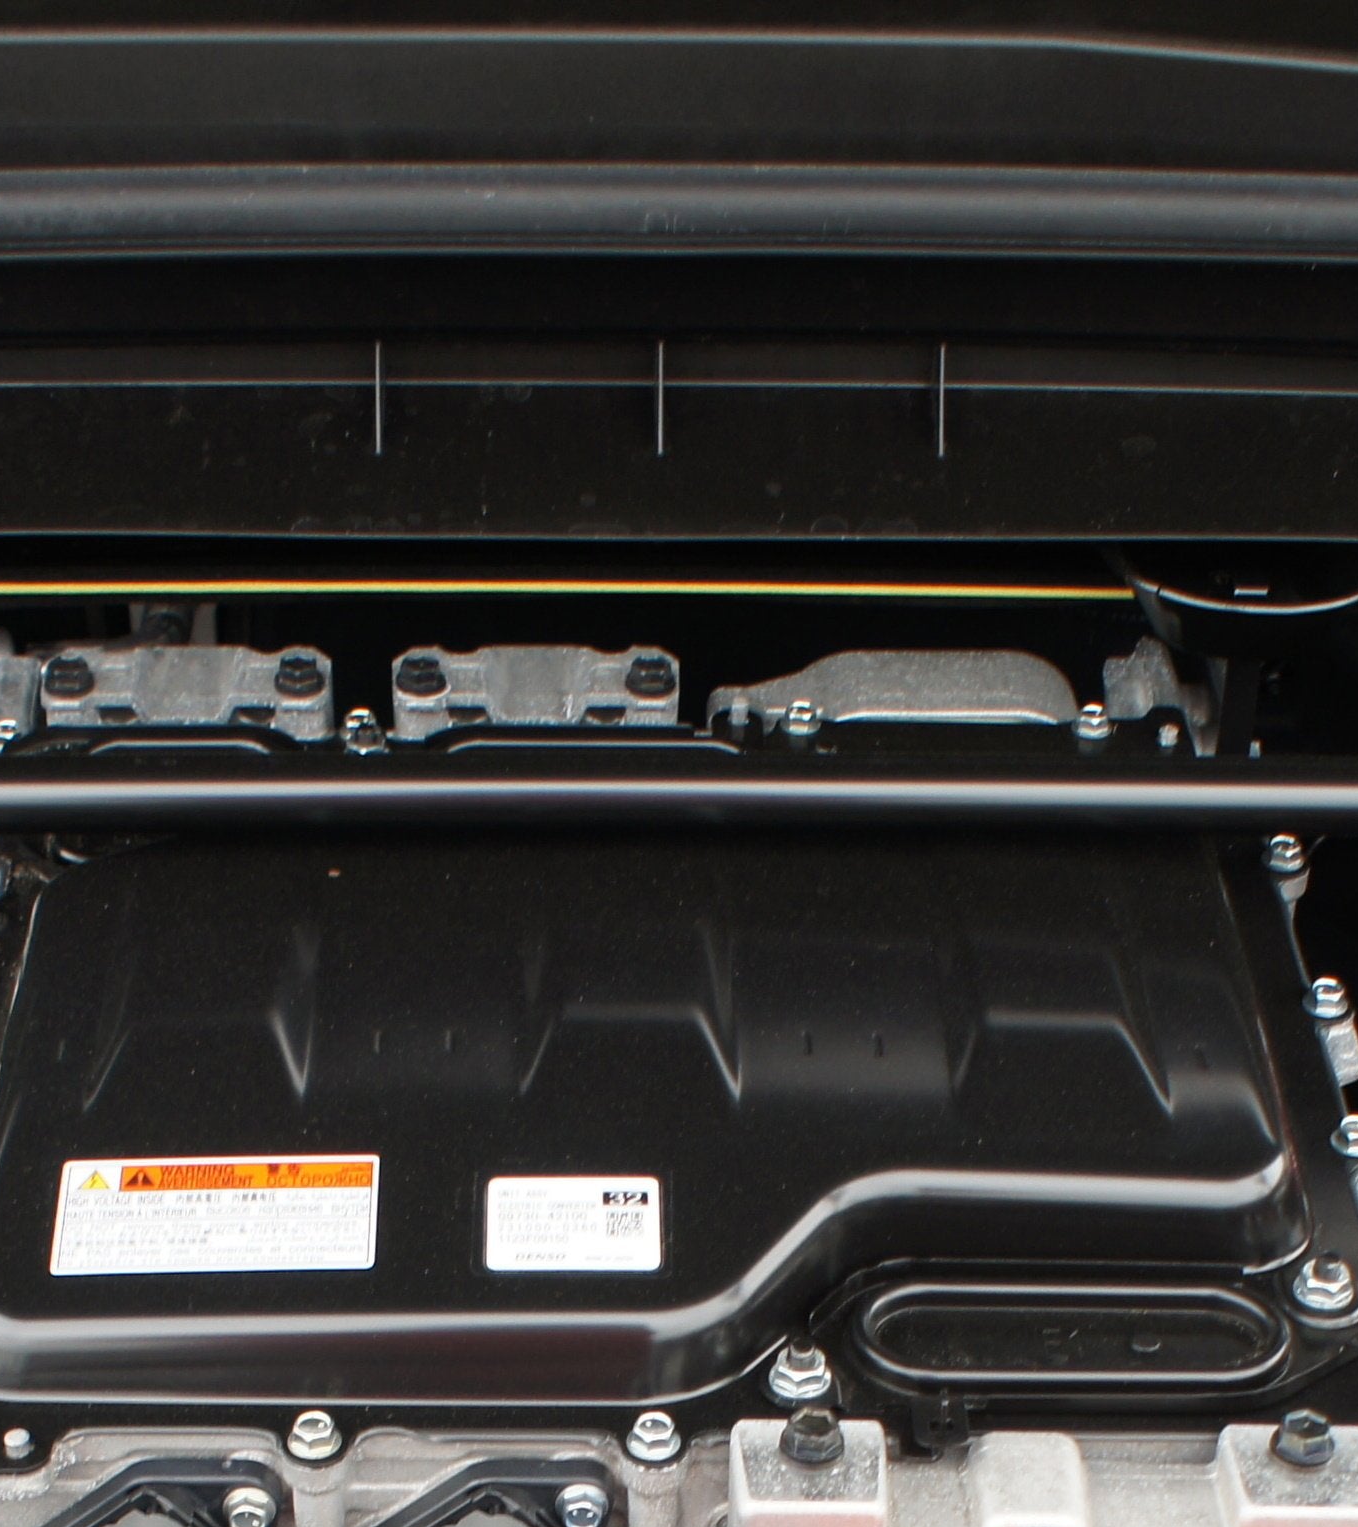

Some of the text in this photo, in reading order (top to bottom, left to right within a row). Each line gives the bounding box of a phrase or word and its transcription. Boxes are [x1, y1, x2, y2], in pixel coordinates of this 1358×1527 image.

[160, 1164, 235, 1178] WARNING
[157, 1176, 254, 1189] AVERTISSEMENT
[608, 1192, 642, 1205] 32
[514, 1252, 568, 1261] DENSO
